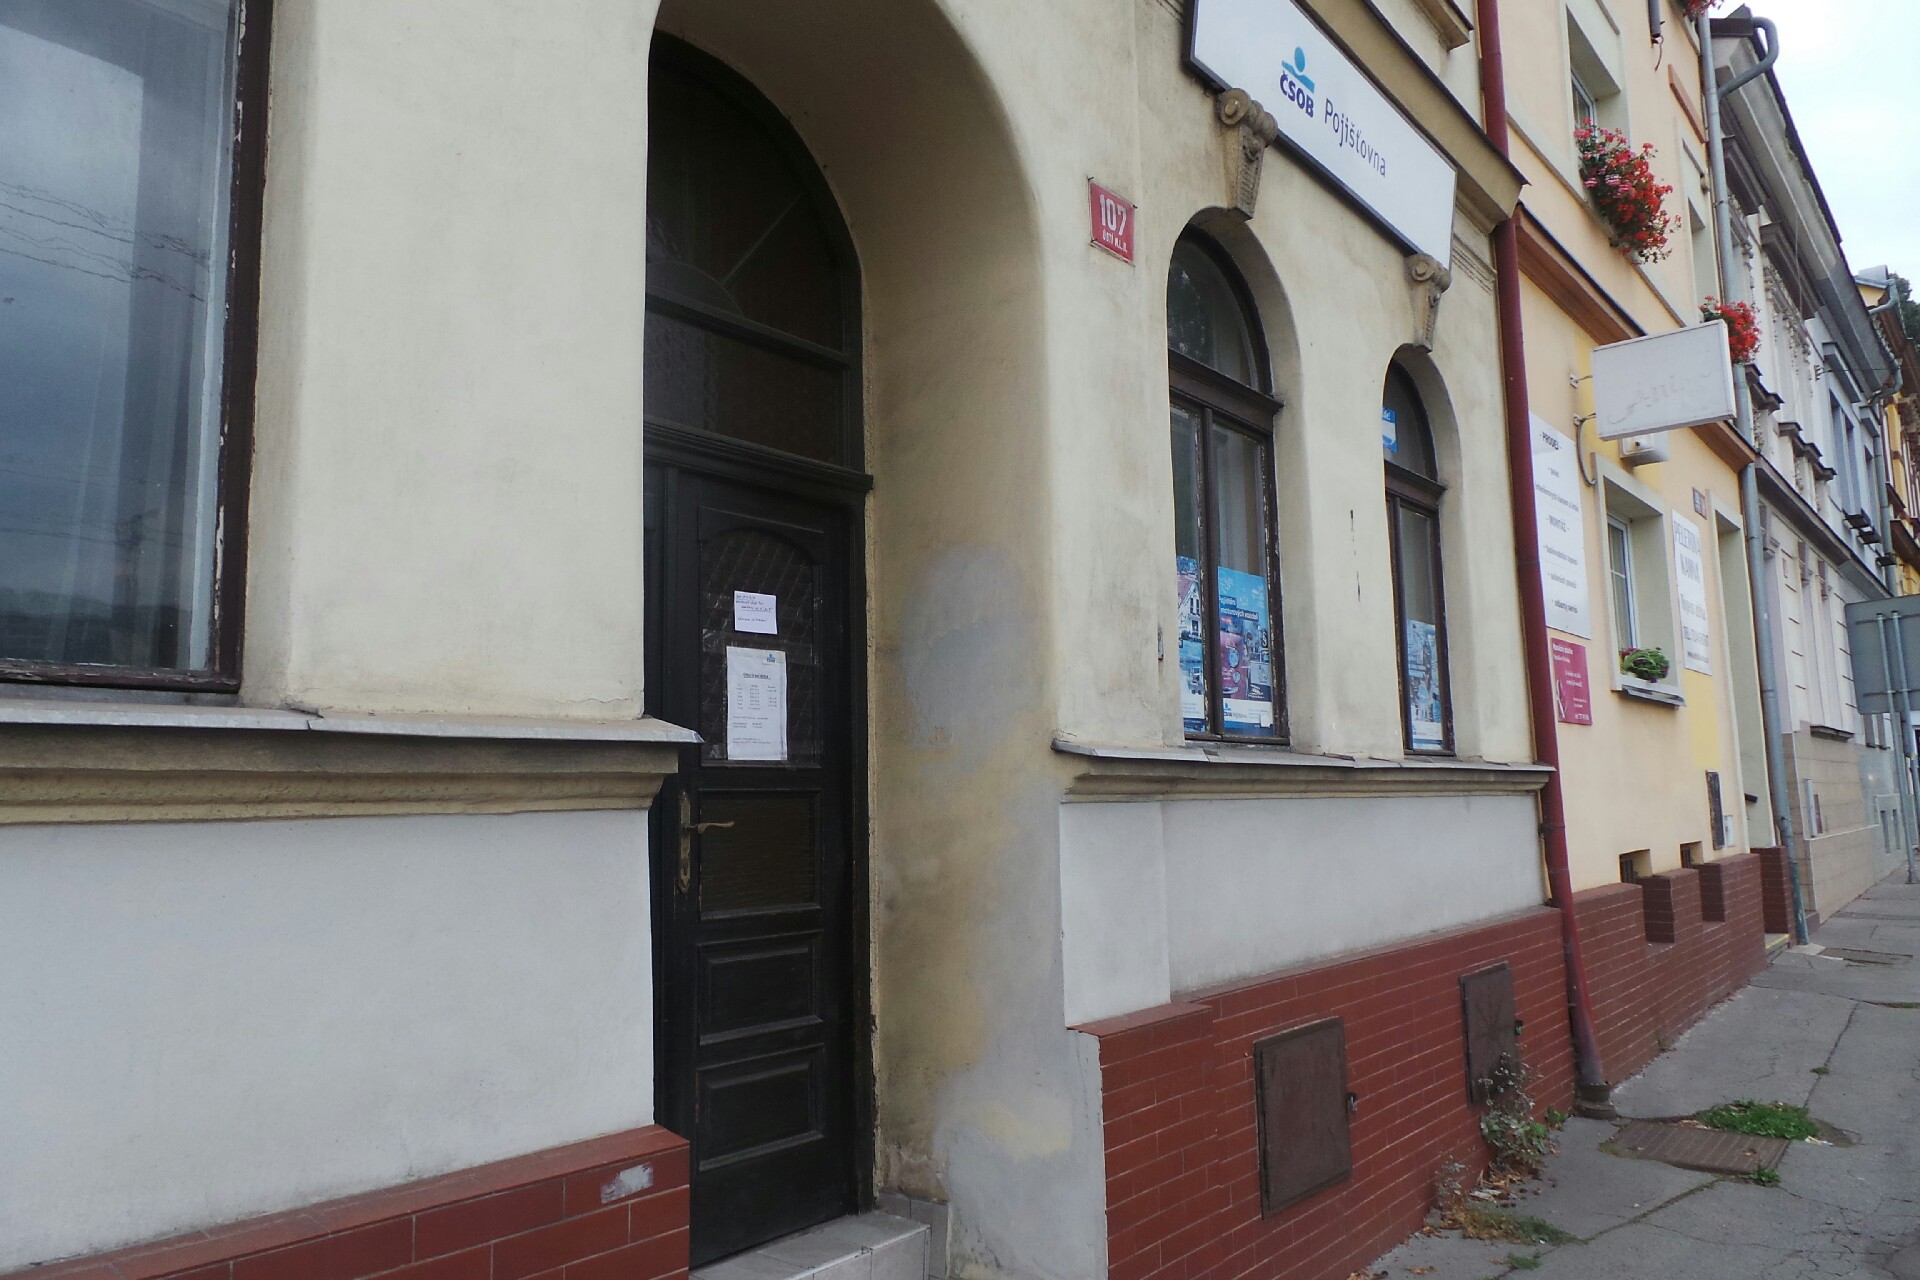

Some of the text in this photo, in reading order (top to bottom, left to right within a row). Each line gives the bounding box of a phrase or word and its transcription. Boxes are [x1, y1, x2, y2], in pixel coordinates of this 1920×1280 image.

[1280, 70, 1386, 178] ČSOB Pojišťovna
[1100, 194, 1127, 236] 107
